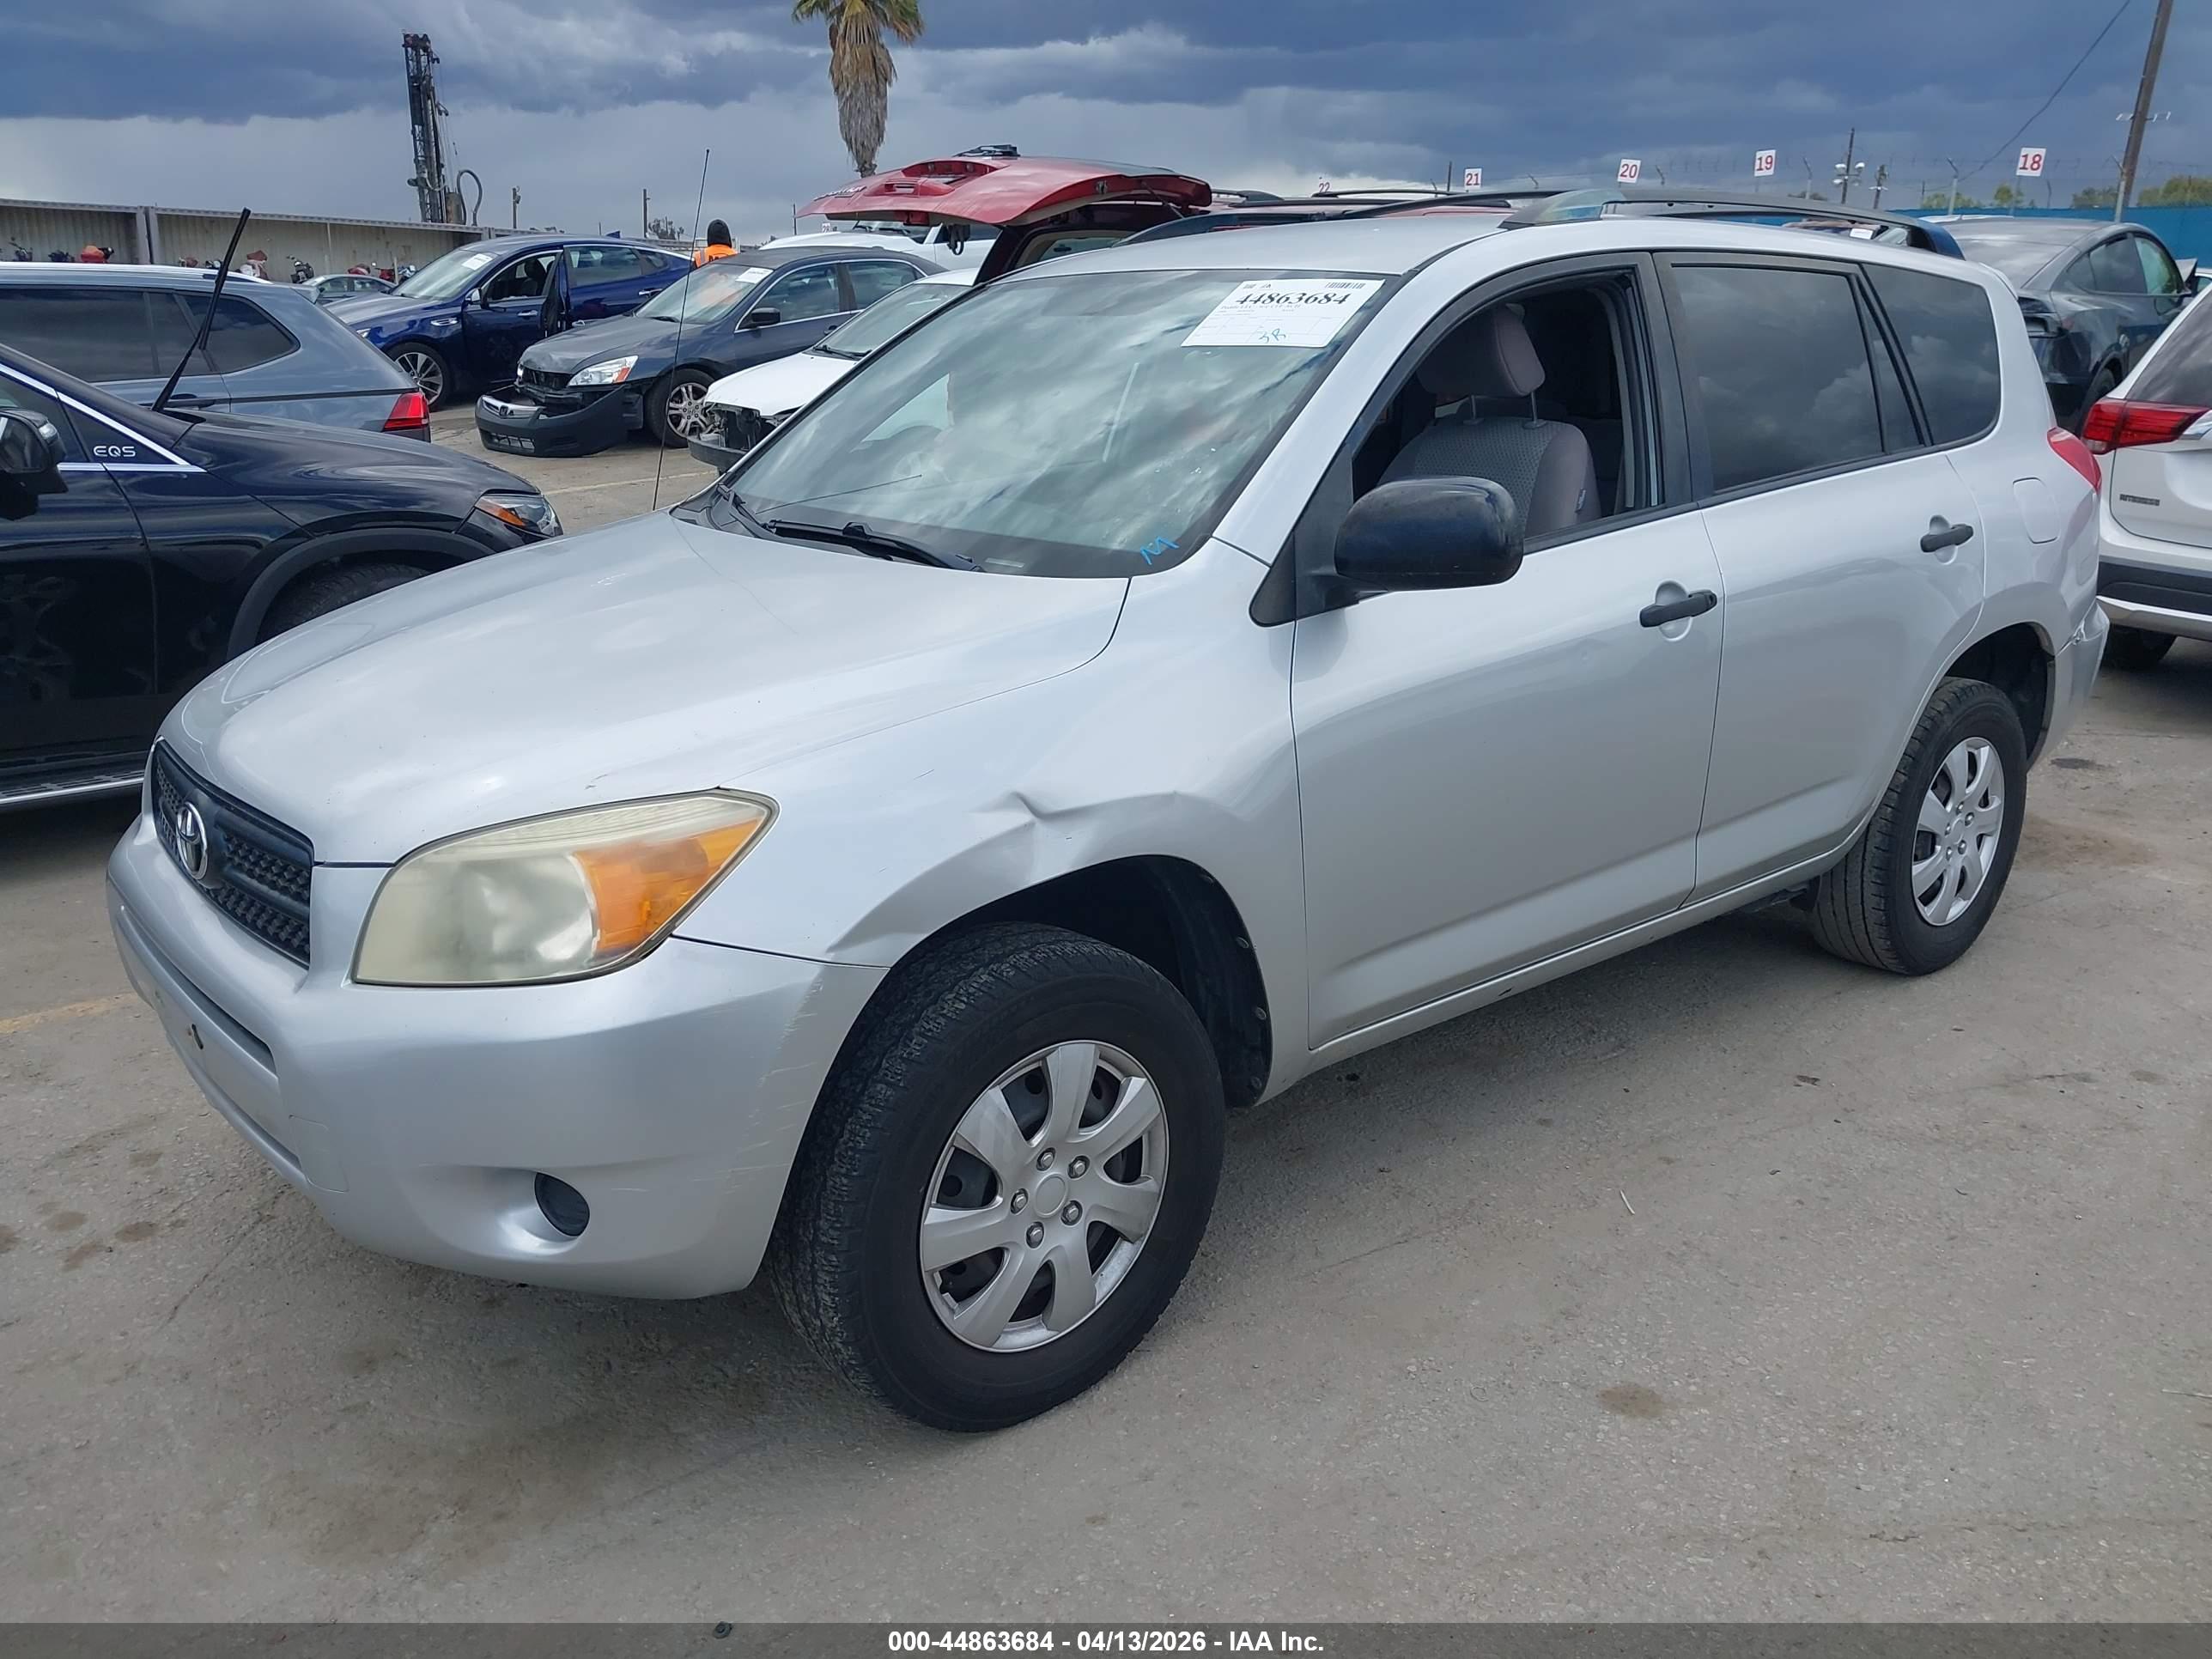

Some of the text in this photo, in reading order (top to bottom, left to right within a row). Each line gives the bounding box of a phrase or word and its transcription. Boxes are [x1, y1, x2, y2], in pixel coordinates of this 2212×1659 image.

[1755, 155, 1774, 172] 19
[2019, 153, 2043, 172] 18
[1620, 162, 1638, 179] 20
[1465, 172, 1480, 186] 21
[1318, 181, 1330, 193] 22
[1235, 292, 1353, 305] 44863684
[93, 445, 136, 458] EQS
